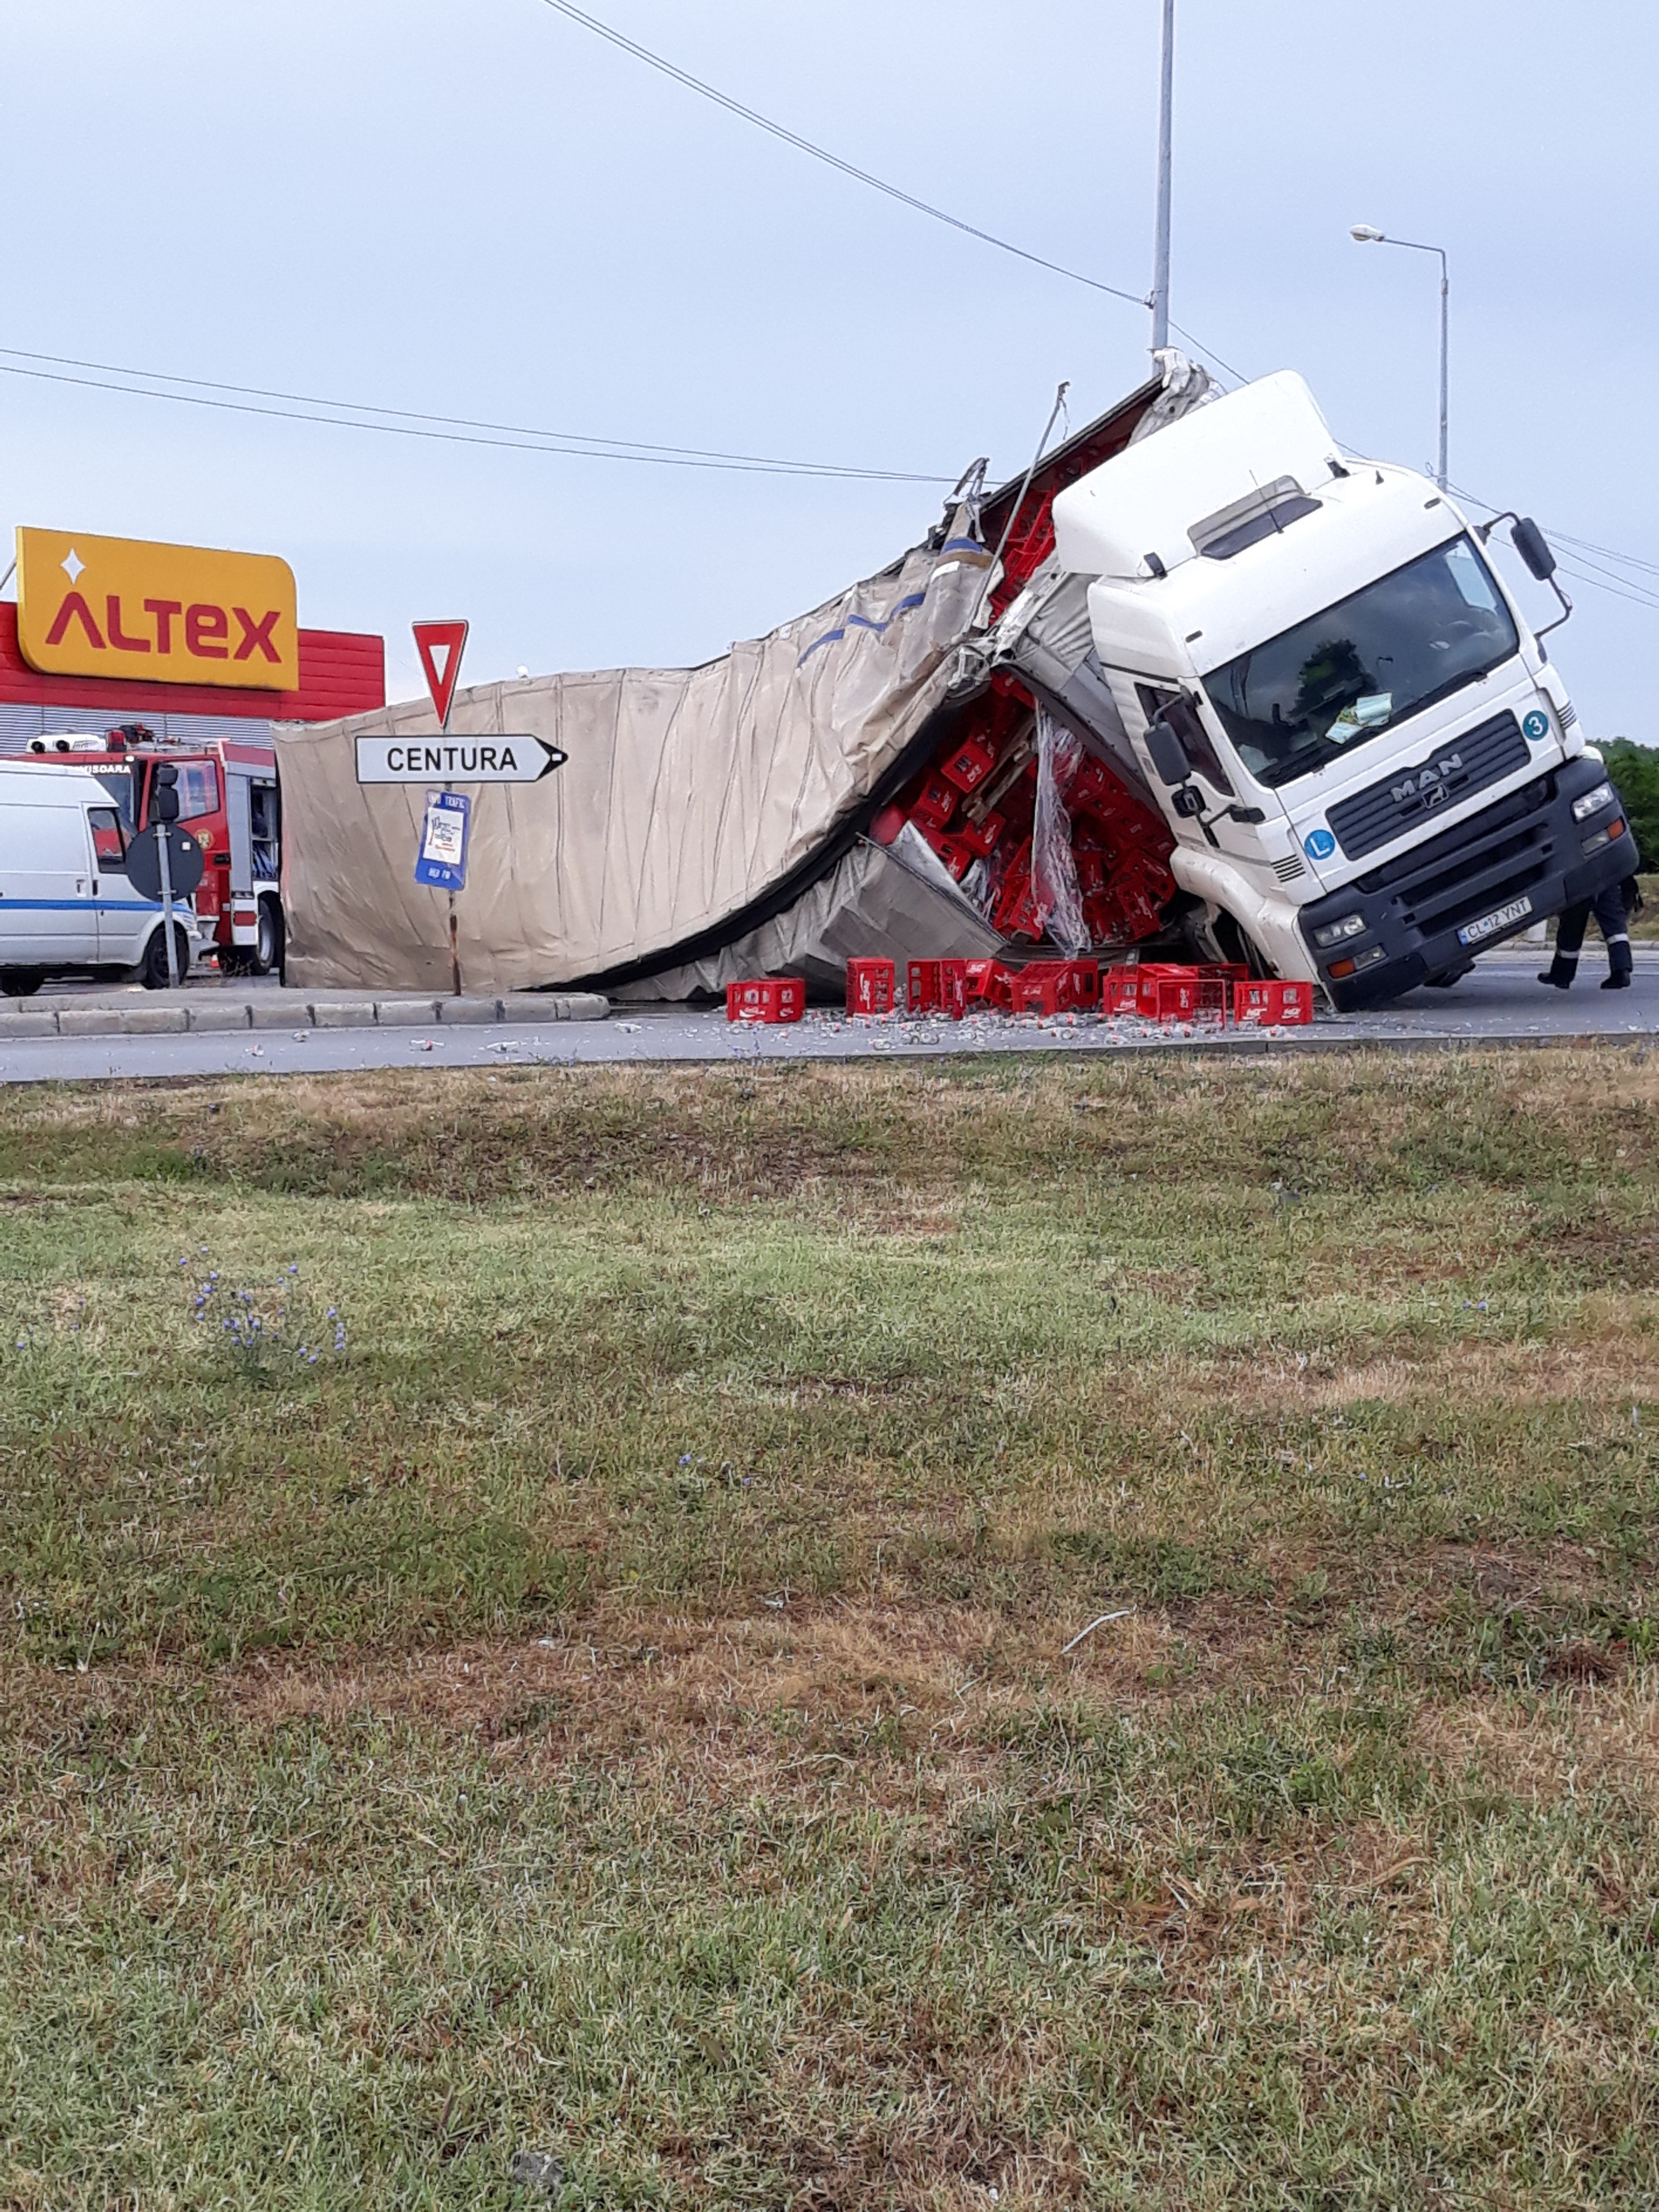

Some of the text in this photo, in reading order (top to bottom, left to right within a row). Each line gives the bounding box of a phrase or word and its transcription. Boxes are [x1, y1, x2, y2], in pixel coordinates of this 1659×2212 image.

[1528, 716, 1543, 735] 3
[387, 747, 518, 771] CENTURA
[1390, 753, 1463, 802] MAN
[1309, 838, 1331, 857] L
[1468, 899, 1527, 938] CL 12 YNT
